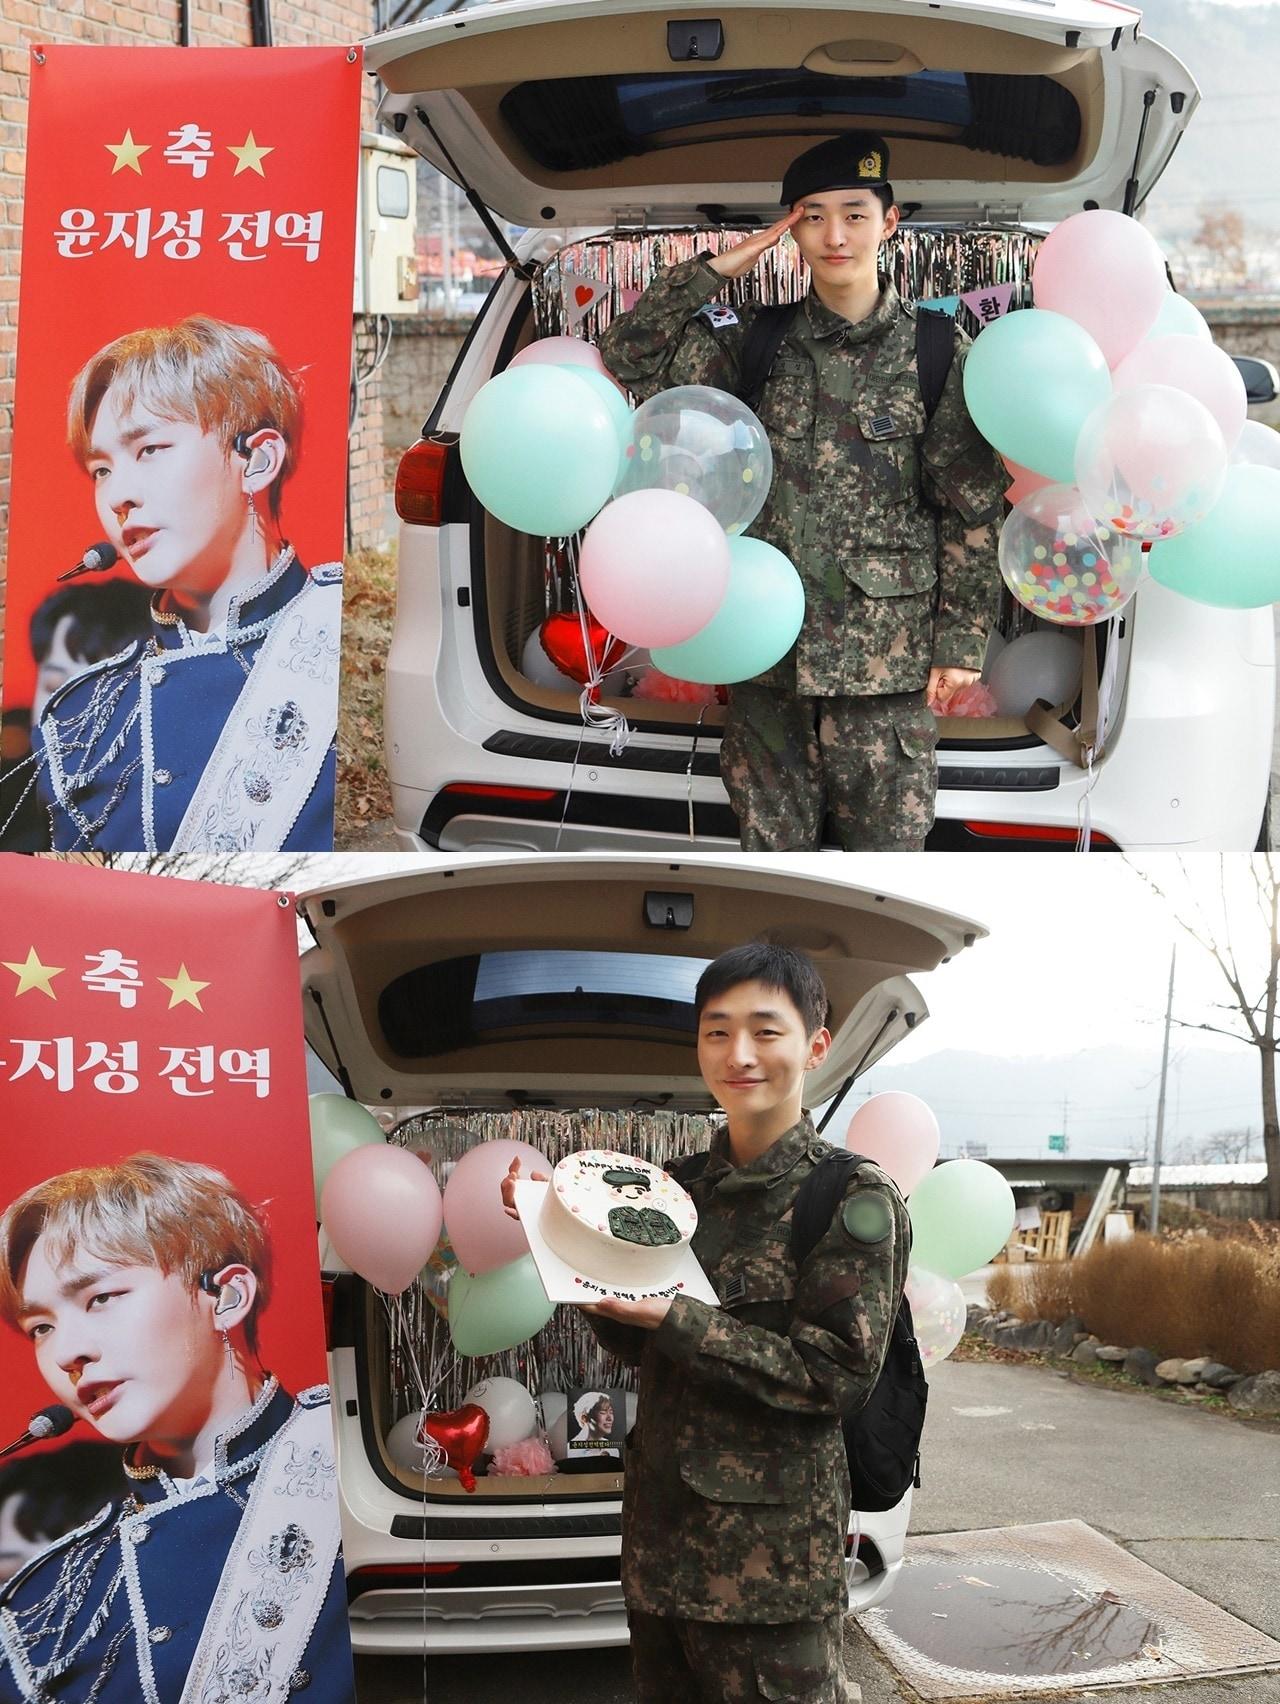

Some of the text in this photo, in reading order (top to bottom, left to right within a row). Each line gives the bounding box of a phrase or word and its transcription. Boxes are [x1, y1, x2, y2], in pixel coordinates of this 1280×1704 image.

[164, 124, 214, 178] 축
[54, 208, 322, 261] 윤지성 전역
[82, 950, 143, 1008] 축
[0, 1037, 269, 1097] 지성 전역
[579, 1160, 613, 1170] HAPPY
[582, 1281, 606, 1295] 윤지성
